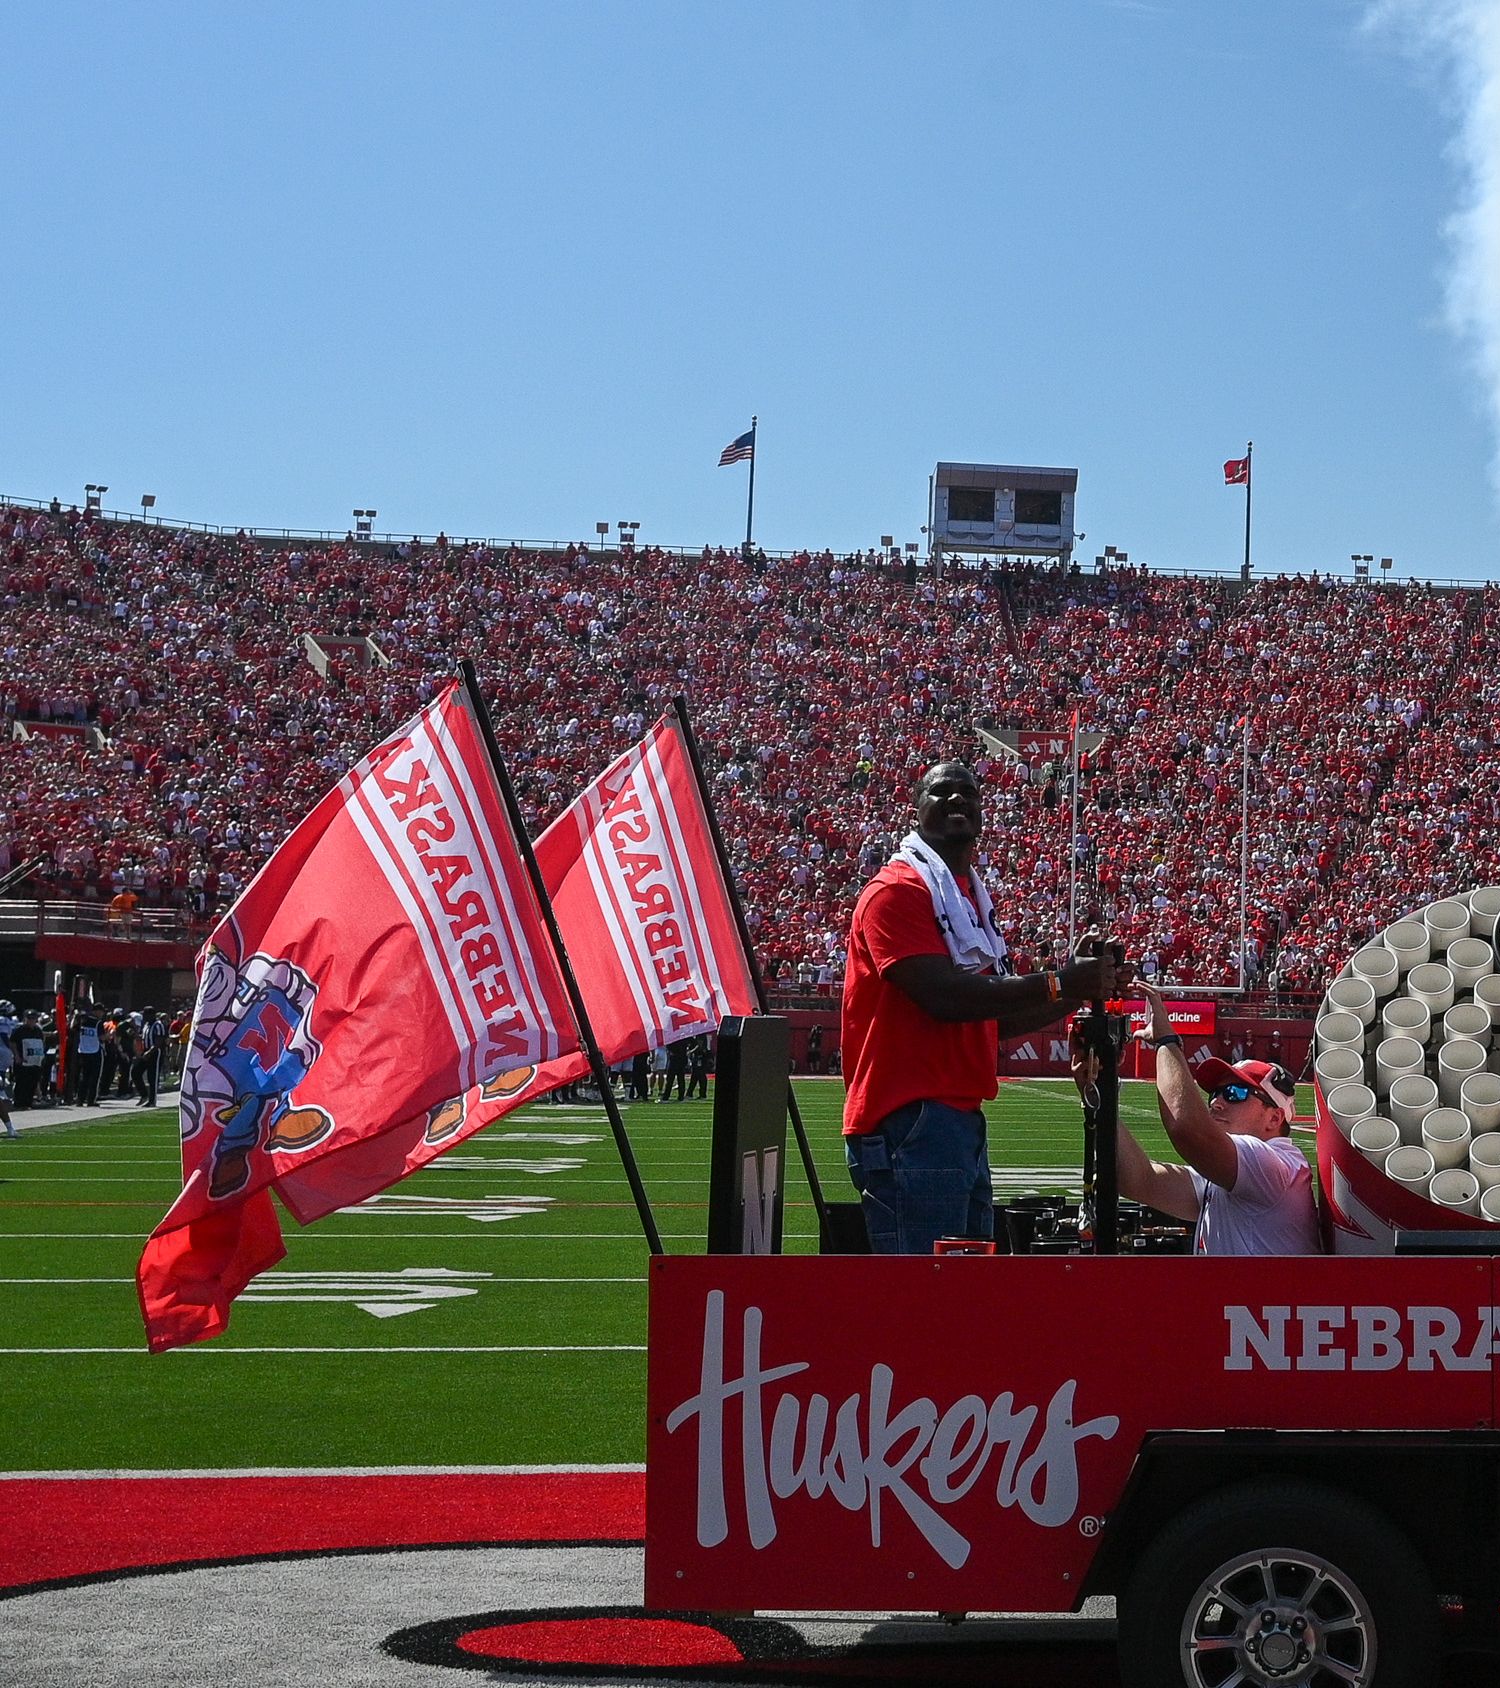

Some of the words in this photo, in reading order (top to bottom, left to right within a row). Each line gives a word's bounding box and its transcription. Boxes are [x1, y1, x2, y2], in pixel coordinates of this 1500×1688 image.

[1163, 1012, 1200, 1022] dicine
[1049, 1040, 1070, 1061] N
[666, 1289, 1120, 1570] Huskers
